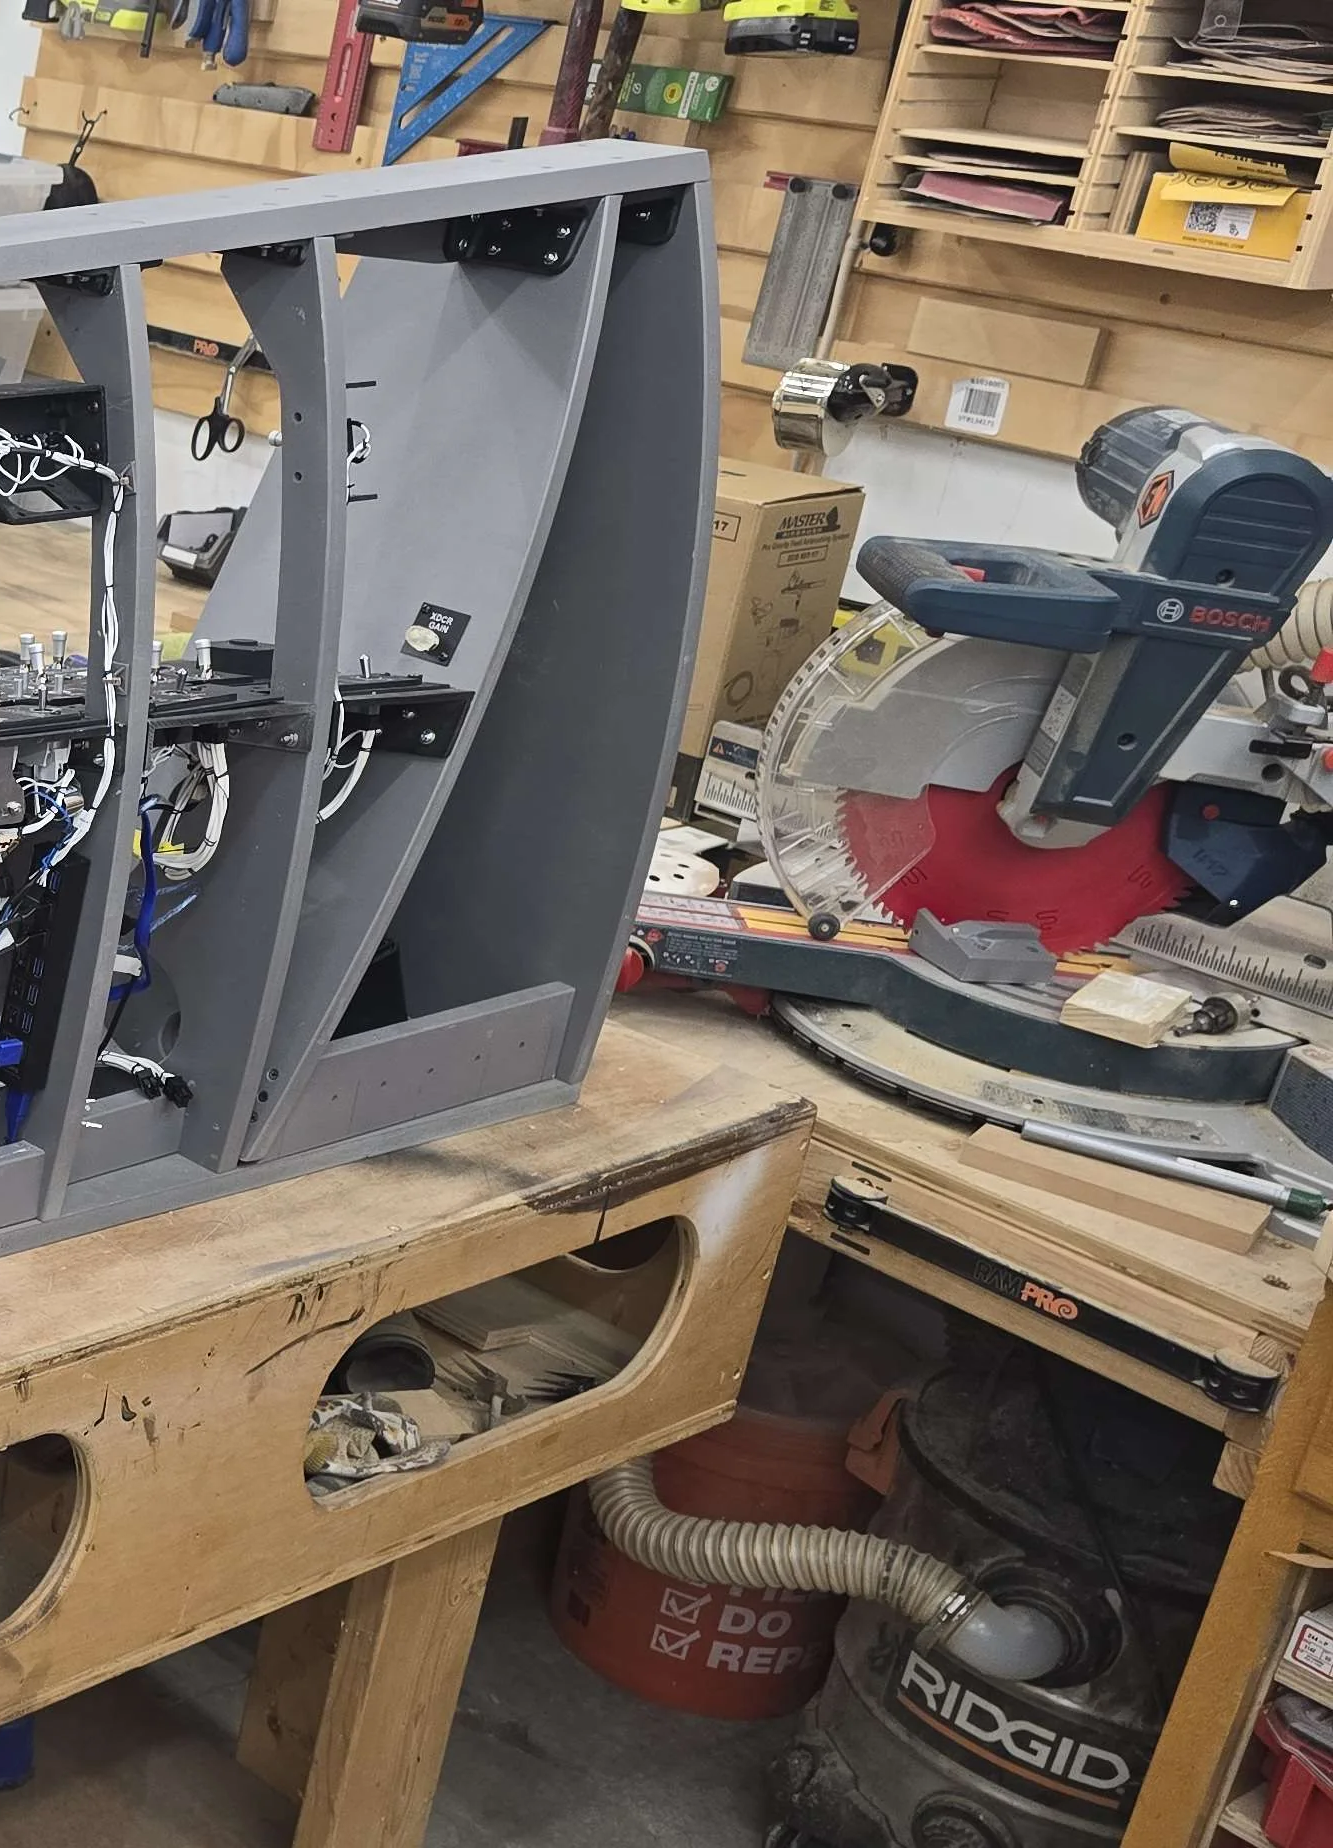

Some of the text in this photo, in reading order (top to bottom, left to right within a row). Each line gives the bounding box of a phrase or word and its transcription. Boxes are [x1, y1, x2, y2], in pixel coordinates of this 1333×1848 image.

[779, 512, 826, 530] MASTER
[428, 621, 450, 634] GAIN
[430, 611, 454, 626] XDCR
[1189, 605, 1272, 633] BOSCH
[718, 1604, 793, 1640] DO
[900, 1650, 1131, 1790] RIDGID
